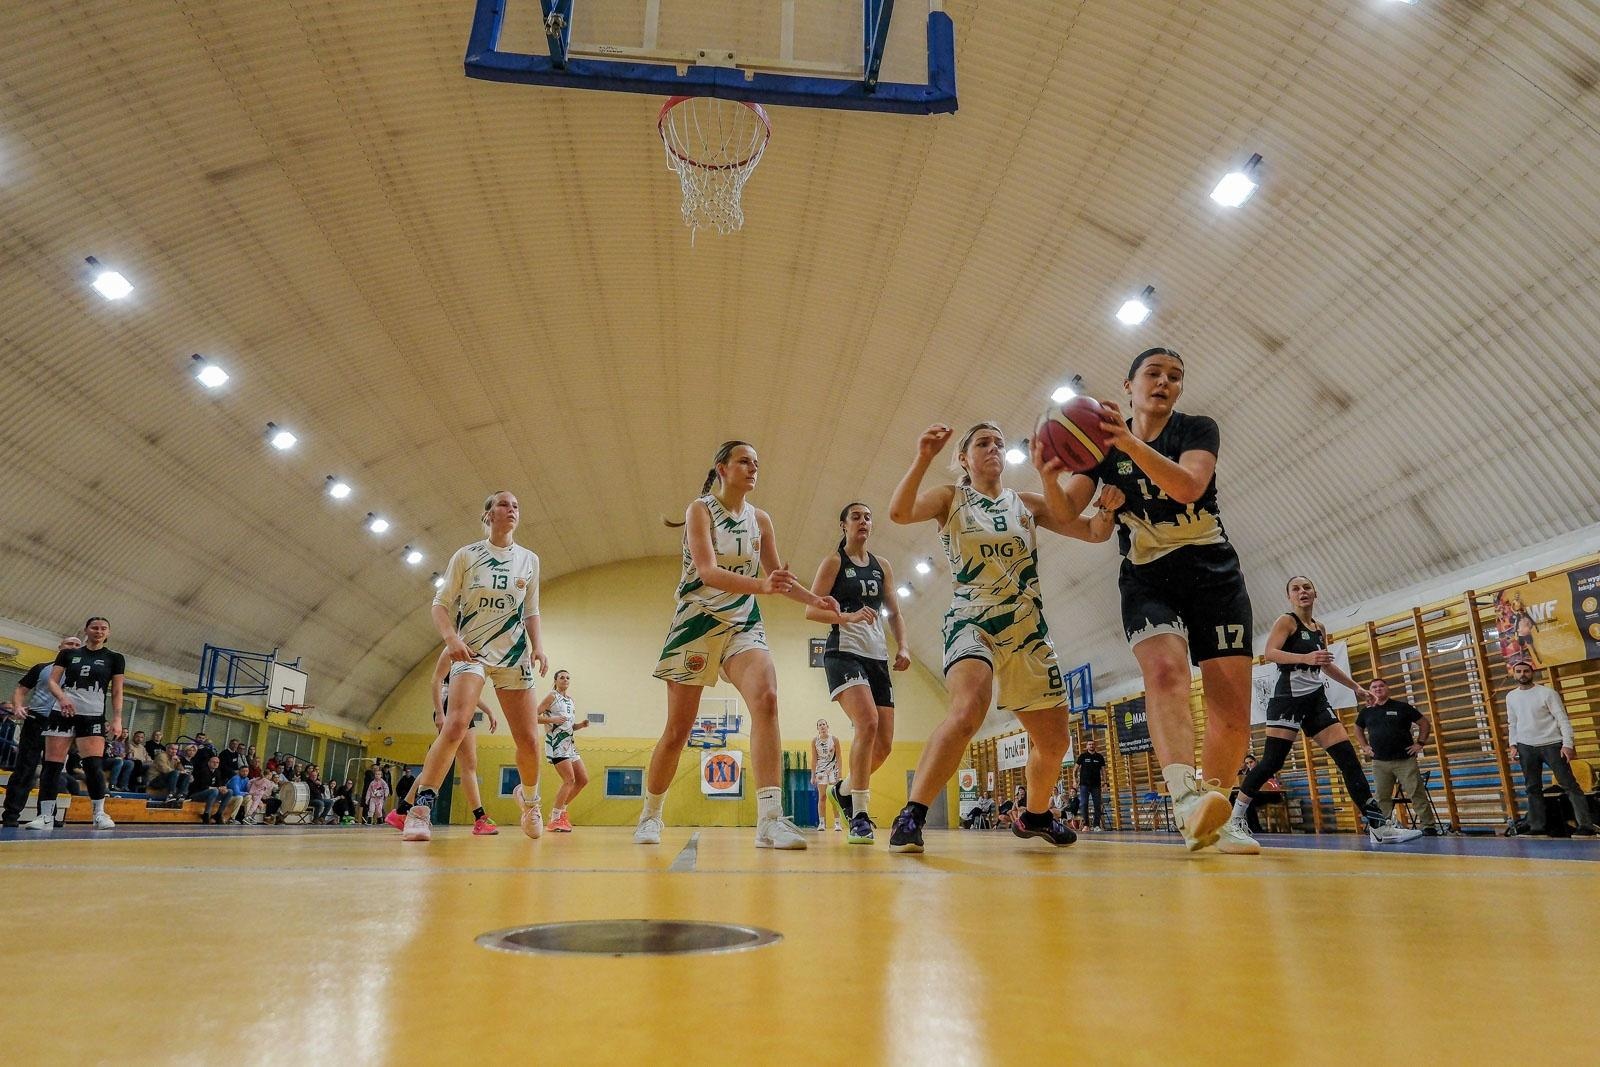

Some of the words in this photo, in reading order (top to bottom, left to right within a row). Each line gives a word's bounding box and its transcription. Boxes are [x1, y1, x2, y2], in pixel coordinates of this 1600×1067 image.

[993, 516, 1008, 531] 8
[736, 538, 741, 556] 1
[980, 543, 1013, 558] DIG
[492, 574, 508, 590] 13
[860, 579, 879, 597] 13
[479, 597, 505, 609] DIG
[1526, 600, 1558, 622] WF
[1215, 624, 1245, 650] 17
[80, 665, 91, 677] 2
[1047, 665, 1062, 689] 8
[92, 723, 102, 734] 2
[1004, 740, 1020, 760] bruk
